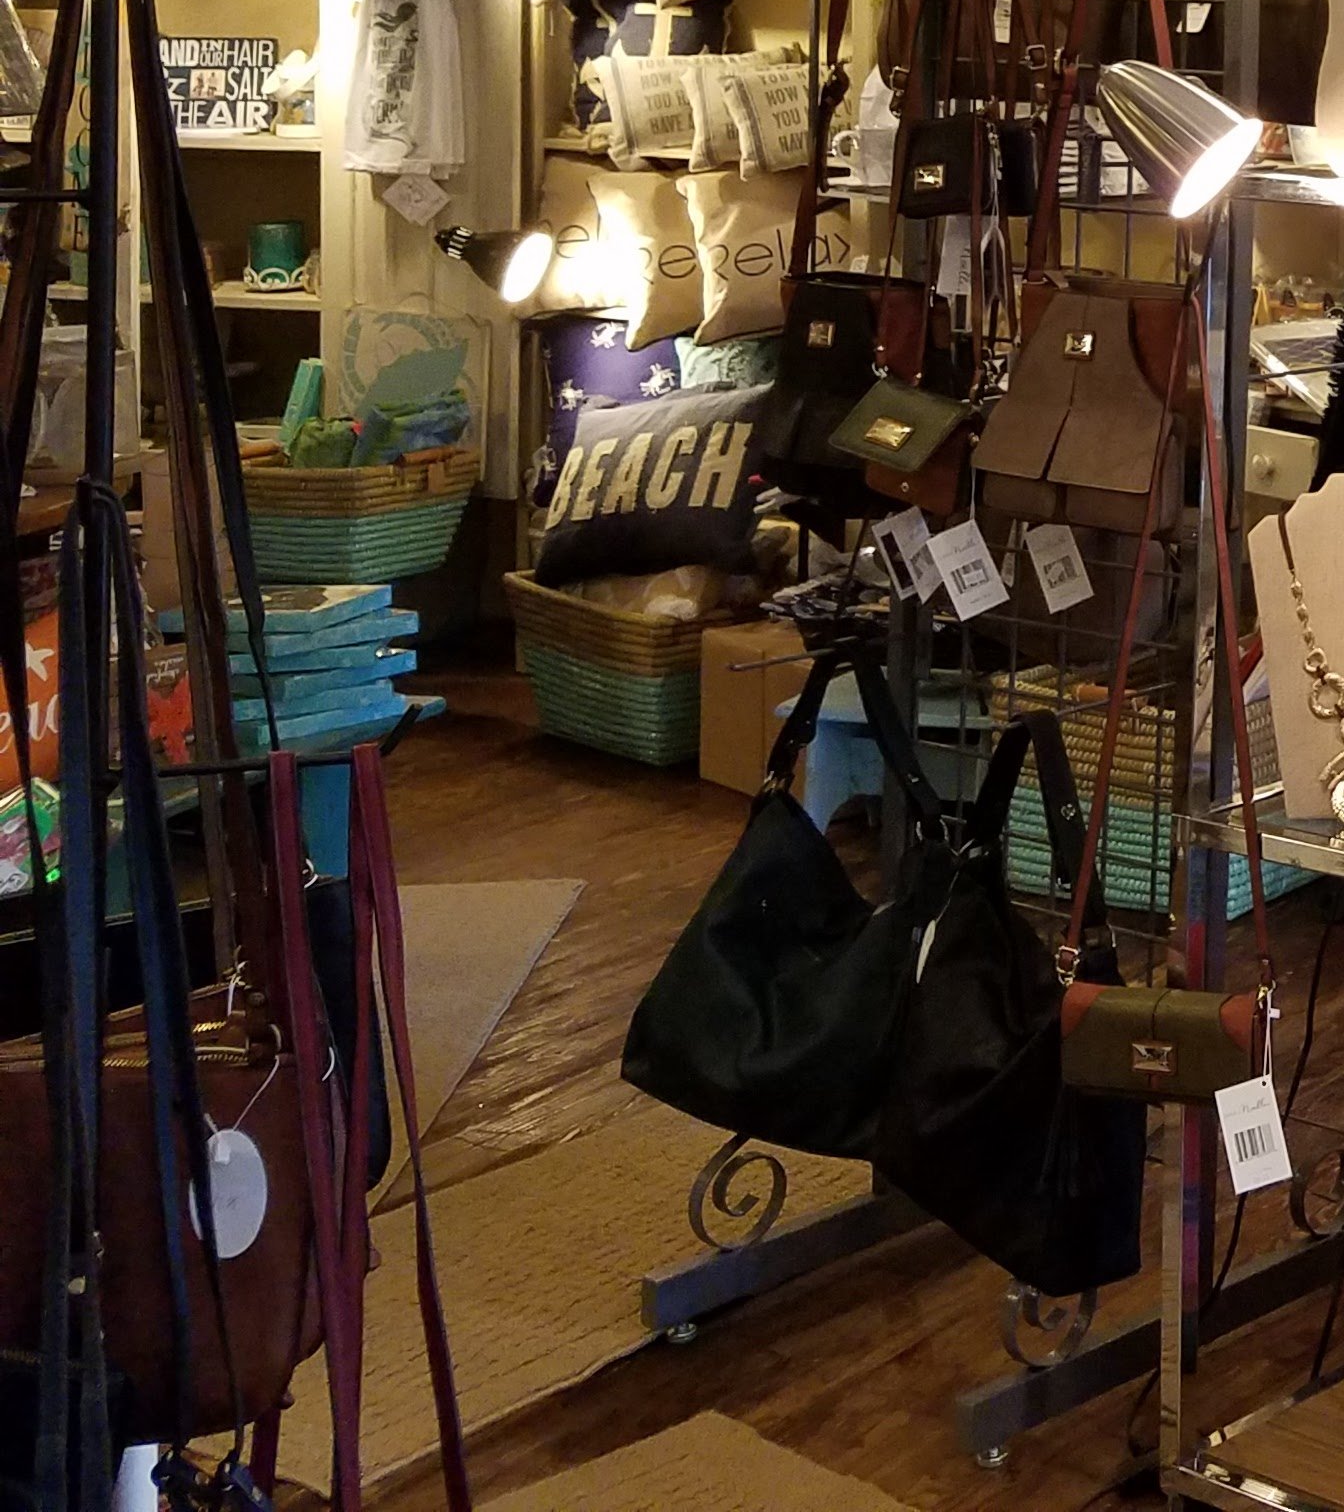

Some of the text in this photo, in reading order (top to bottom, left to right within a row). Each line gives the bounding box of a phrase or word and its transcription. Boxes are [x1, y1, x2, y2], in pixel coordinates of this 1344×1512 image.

[160, 39, 274, 67] AND IN OUR HAIR
[226, 67, 272, 101] SALT
[645, 95, 670, 111] YOU
[765, 86, 798, 107] HOW
[206, 101, 269, 128] AIR
[772, 108, 801, 128] YOU
[649, 117, 682, 135] HAVE
[778, 132, 808, 153] HAV
[544, 420, 753, 530] BEACH
